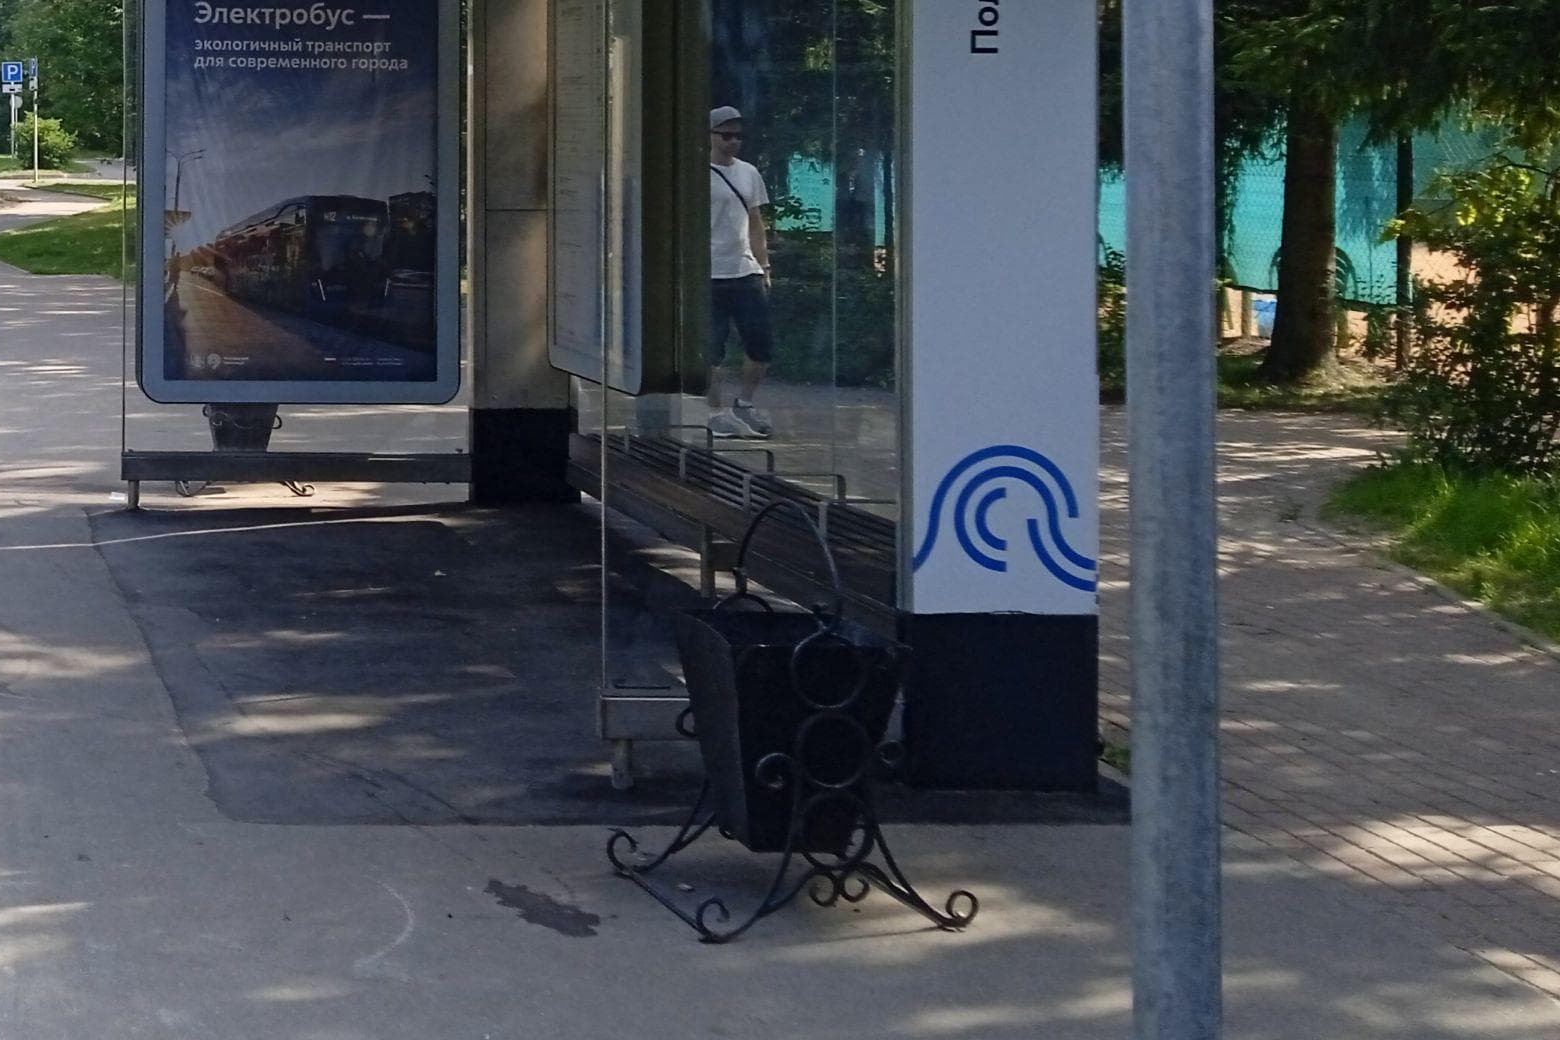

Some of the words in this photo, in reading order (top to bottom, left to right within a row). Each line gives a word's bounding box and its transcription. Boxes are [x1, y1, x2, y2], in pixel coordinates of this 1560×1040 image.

[194, 1, 355, 30] Электробус
[194, 38, 302, 52] экологичный
[306, 40, 391, 55] транспорт
[194, 56, 224, 70] для
[228, 56, 347, 70] современного
[351, 58, 409, 71] города
[7, 64, 19, 80] P
